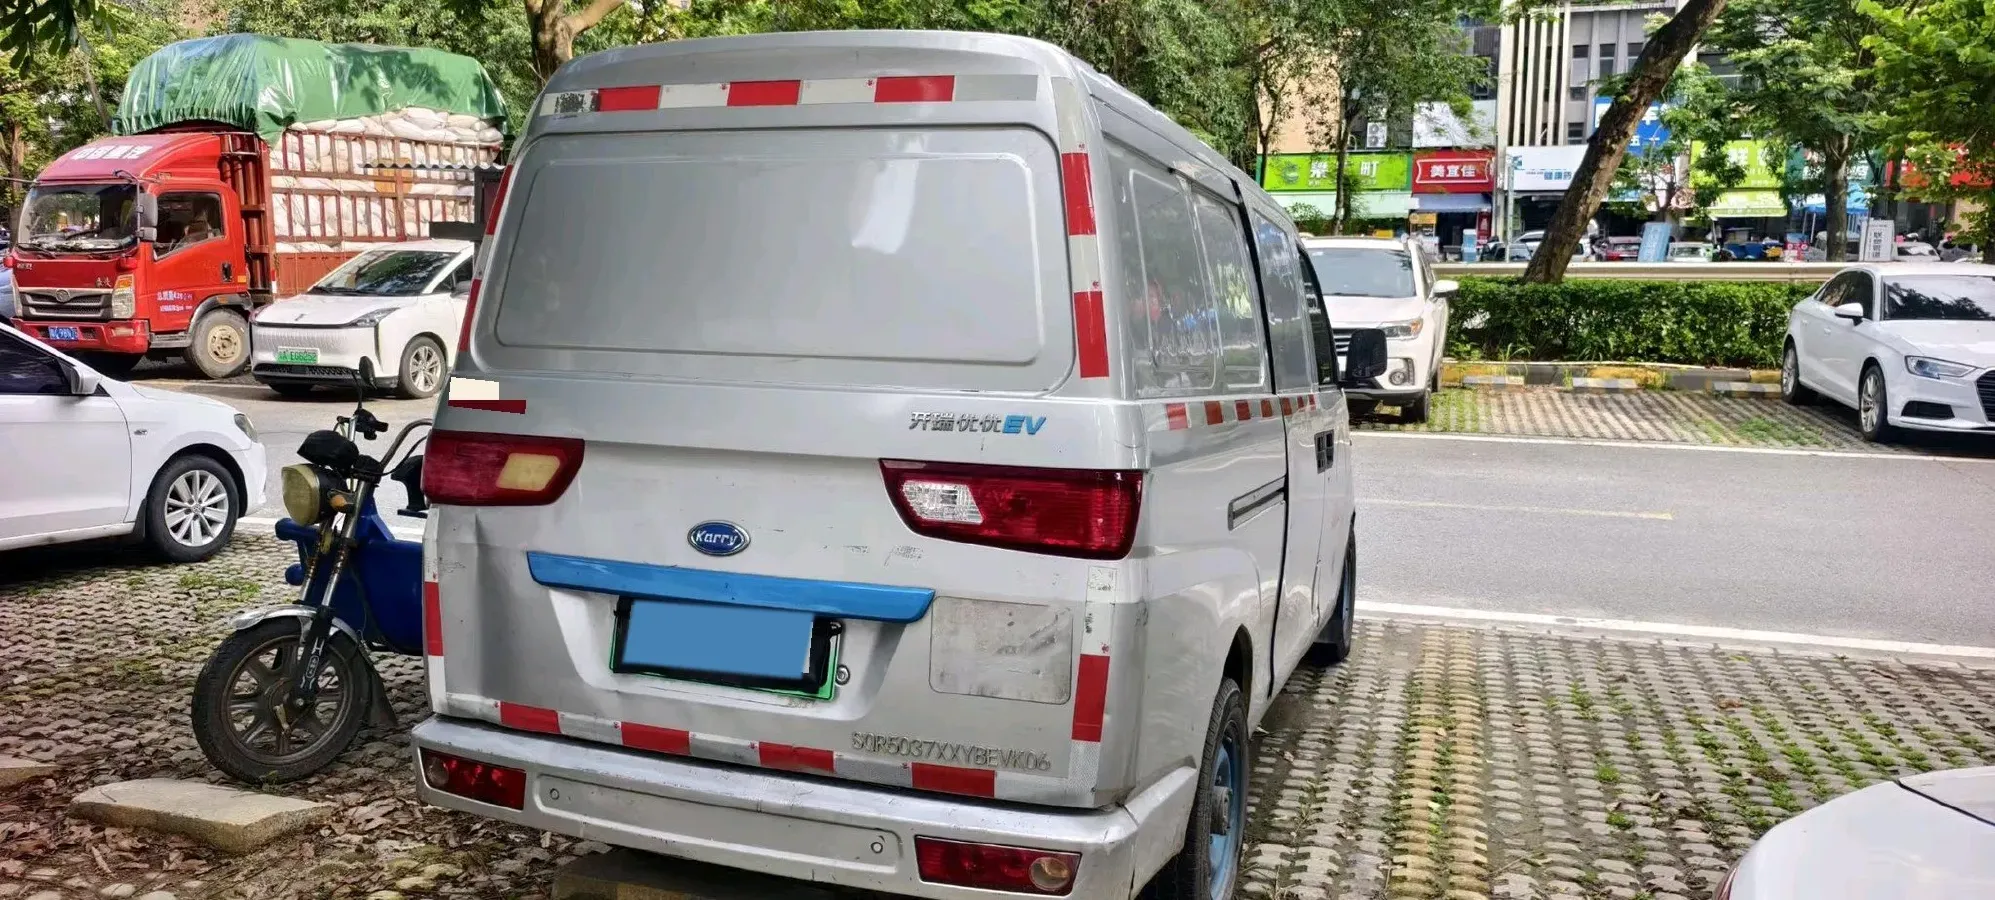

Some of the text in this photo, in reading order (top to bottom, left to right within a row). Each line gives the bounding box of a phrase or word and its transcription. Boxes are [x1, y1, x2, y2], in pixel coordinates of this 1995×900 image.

[1430, 164, 1476, 178] 美宜佳
[695, 530, 738, 546] Karry
[851, 731, 1051, 771] SQR5037XXYBEVK06
